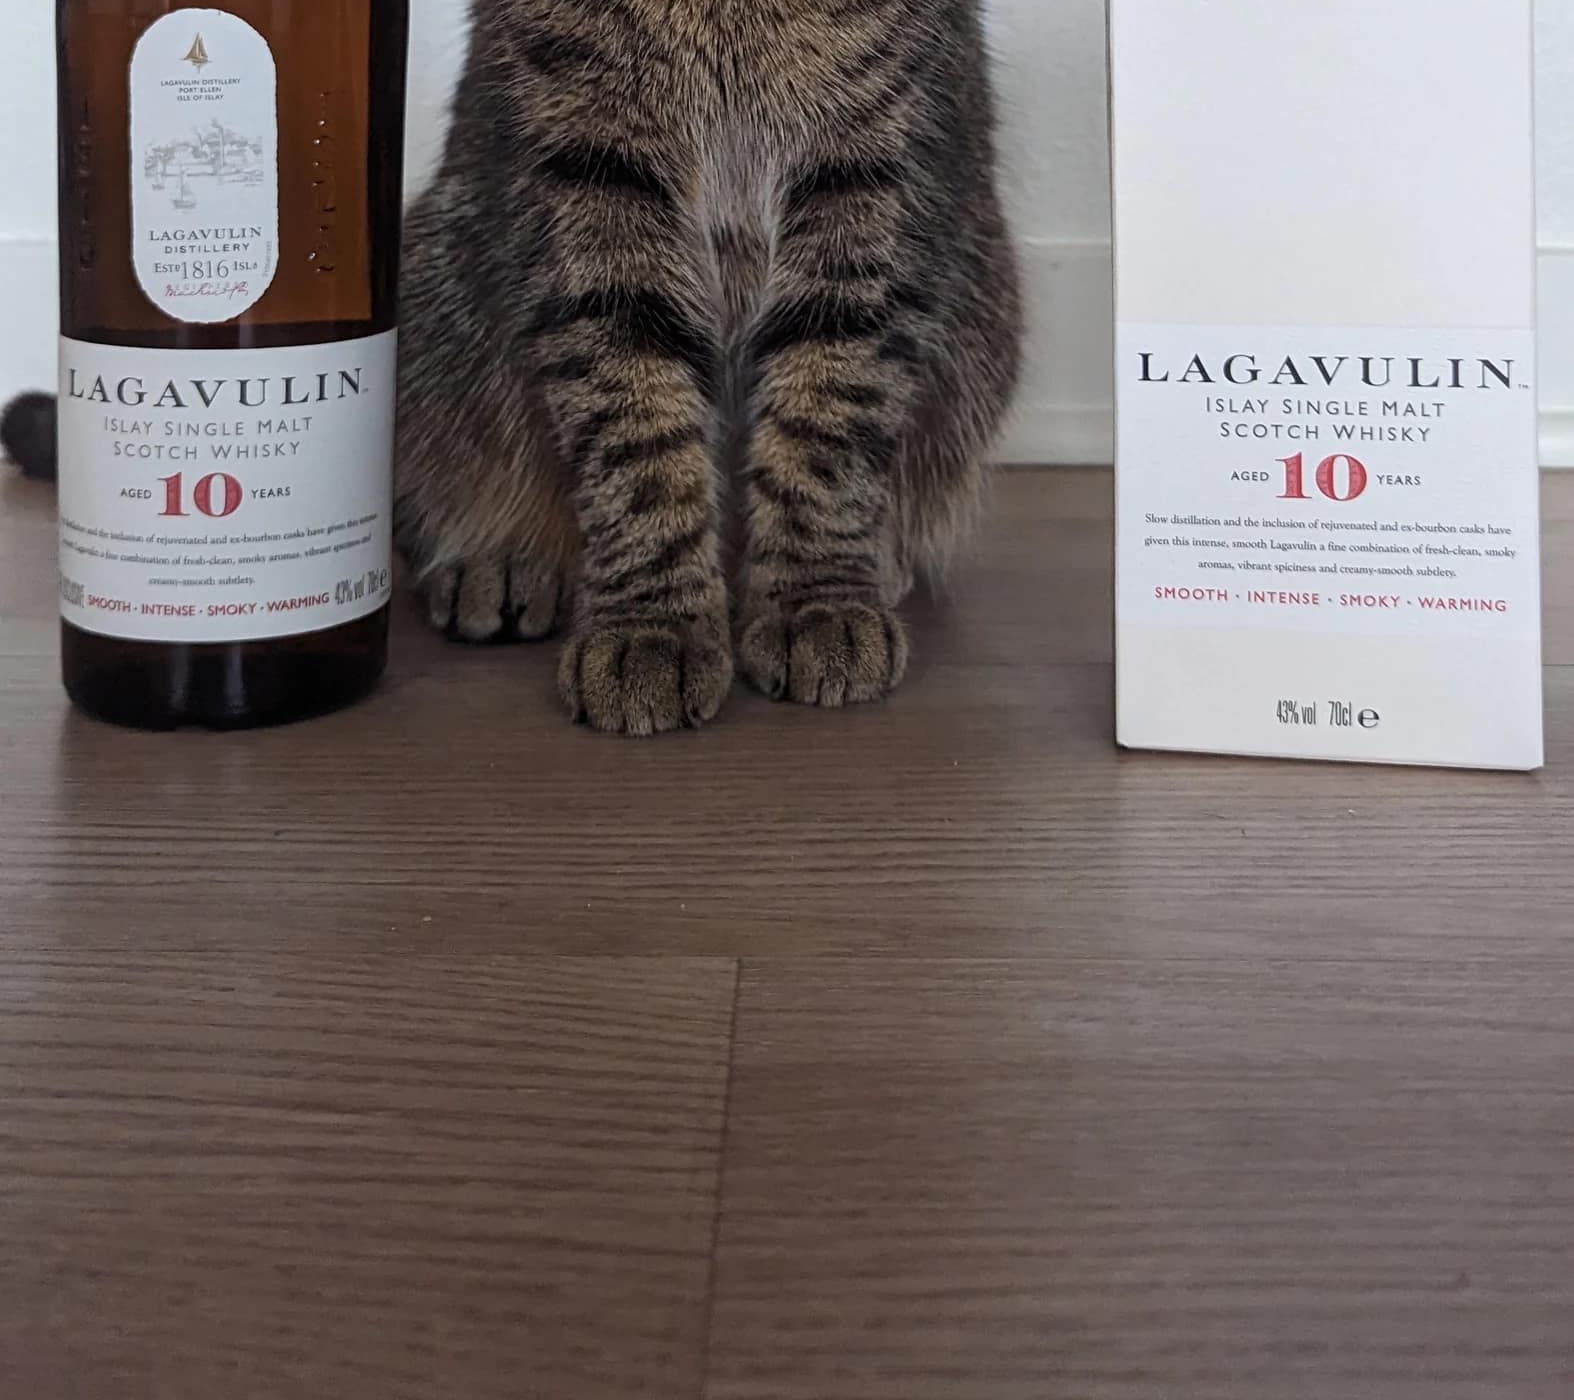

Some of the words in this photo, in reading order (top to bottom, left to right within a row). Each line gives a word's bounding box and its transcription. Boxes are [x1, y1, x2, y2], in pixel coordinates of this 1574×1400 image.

[149, 226, 262, 241] LAGAVULIN
[164, 243, 250, 254] DISTILLERY
[182, 260, 229, 279] 1816
[1137, 352, 1515, 389] LAGAVULIN
[68, 367, 363, 408] LAGAVULIN
[1206, 396, 1269, 415] ISLAY
[1282, 399, 1369, 417] SINGLE
[1381, 401, 1446, 418] MALT
[104, 415, 153, 435] ISLAY
[164, 421, 245, 436] SINGLE
[257, 416, 313, 434] MALT
[1220, 422, 1320, 441] SCOTCH
[1333, 424, 1431, 443] WHISKY
[113, 441, 198, 460] SCOTCH
[211, 441, 301, 460] WHISKY
[1230, 470, 1270, 482] AGED
[1275, 451, 1368, 501] 10
[1376, 473, 1422, 486] YEARS
[120, 488, 152, 499] AGED
[156, 471, 243, 517] 10
[251, 486, 292, 499] YEARS
[1145, 512, 1168, 524] Slow
[1170, 514, 1221, 526] distillation
[1223, 516, 1241, 527] and
[1244, 517, 1259, 528] the
[1262, 516, 1306, 528] inclusion
[1308, 518, 1319, 529] of
[1321, 521, 1377, 532] rejuvenated
[1380, 522, 1398, 532] and
[1401, 522, 1457, 533] ex-bourbon
[1459, 523, 1485, 534] casks
[1487, 524, 1512, 535] have
[156, 535, 208, 546] rejuvenated
[210, 534, 227, 544] and
[230, 532, 281, 544] ex-bourbon
[1144, 536, 1169, 547] given
[1172, 536, 1190, 546] this
[1192, 537, 1229, 548] intense,
[1232, 538, 1267, 549] smooth
[1270, 540, 1316, 551] Lagavulin
[1328, 540, 1347, 551] fine
[1349, 543, 1410, 554] combination
[1412, 543, 1424, 554] of
[1425, 544, 1482, 556] fresh-clean,
[1484, 545, 1516, 558] smoky
[172, 555, 181, 565] of
[238, 554, 266, 565] smoky
[1198, 559, 1234, 570] aromas,
[1238, 560, 1272, 571] vibrant
[1274, 561, 1316, 573] spiciness
[1319, 563, 1337, 573] and
[1339, 564, 1413, 576] creamy-smooth
[1416, 566, 1456, 577] subtlety.
[88, 594, 132, 612] SMOOTH
[141, 604, 196, 616] INTENSE
[207, 603, 257, 616] SMOKY
[267, 592, 330, 612] WARMING
[1155, 586, 1229, 601] SMOOTH
[1248, 590, 1320, 605] INTENSE
[1339, 593, 1400, 608] SMOKY
[1418, 596, 1507, 612] WARMING
[1276, 699, 1299, 724] 43%
[1301, 701, 1316, 725] vol
[1328, 700, 1352, 726] 70cl
